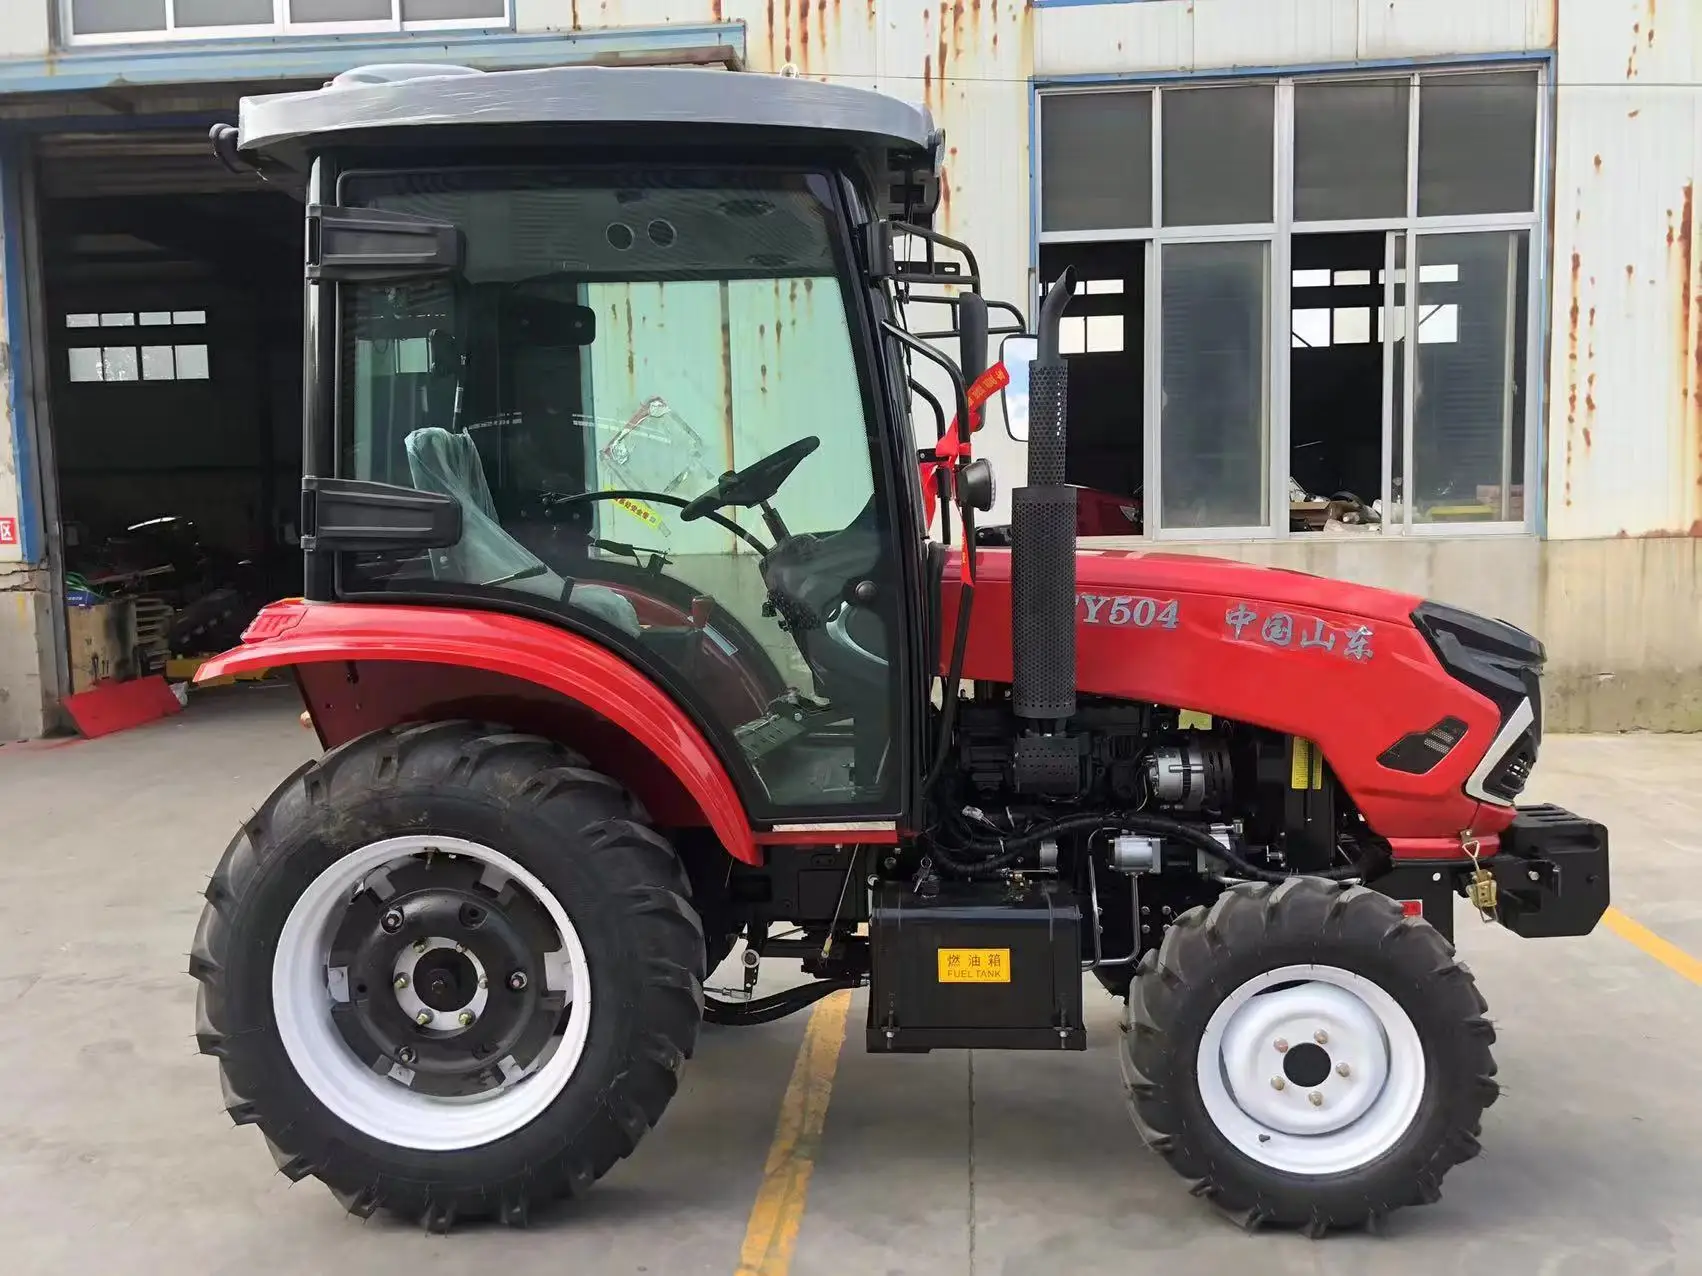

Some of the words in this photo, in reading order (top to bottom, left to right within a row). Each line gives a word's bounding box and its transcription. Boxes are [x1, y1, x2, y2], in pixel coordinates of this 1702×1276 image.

[1075, 592, 1180, 629] Y504
[1225, 602, 1375, 662] 中国山东
[947, 953, 1001, 967] 燃油箱
[947, 969, 973, 978] FUEL
[976, 969, 1002, 978] TANK
